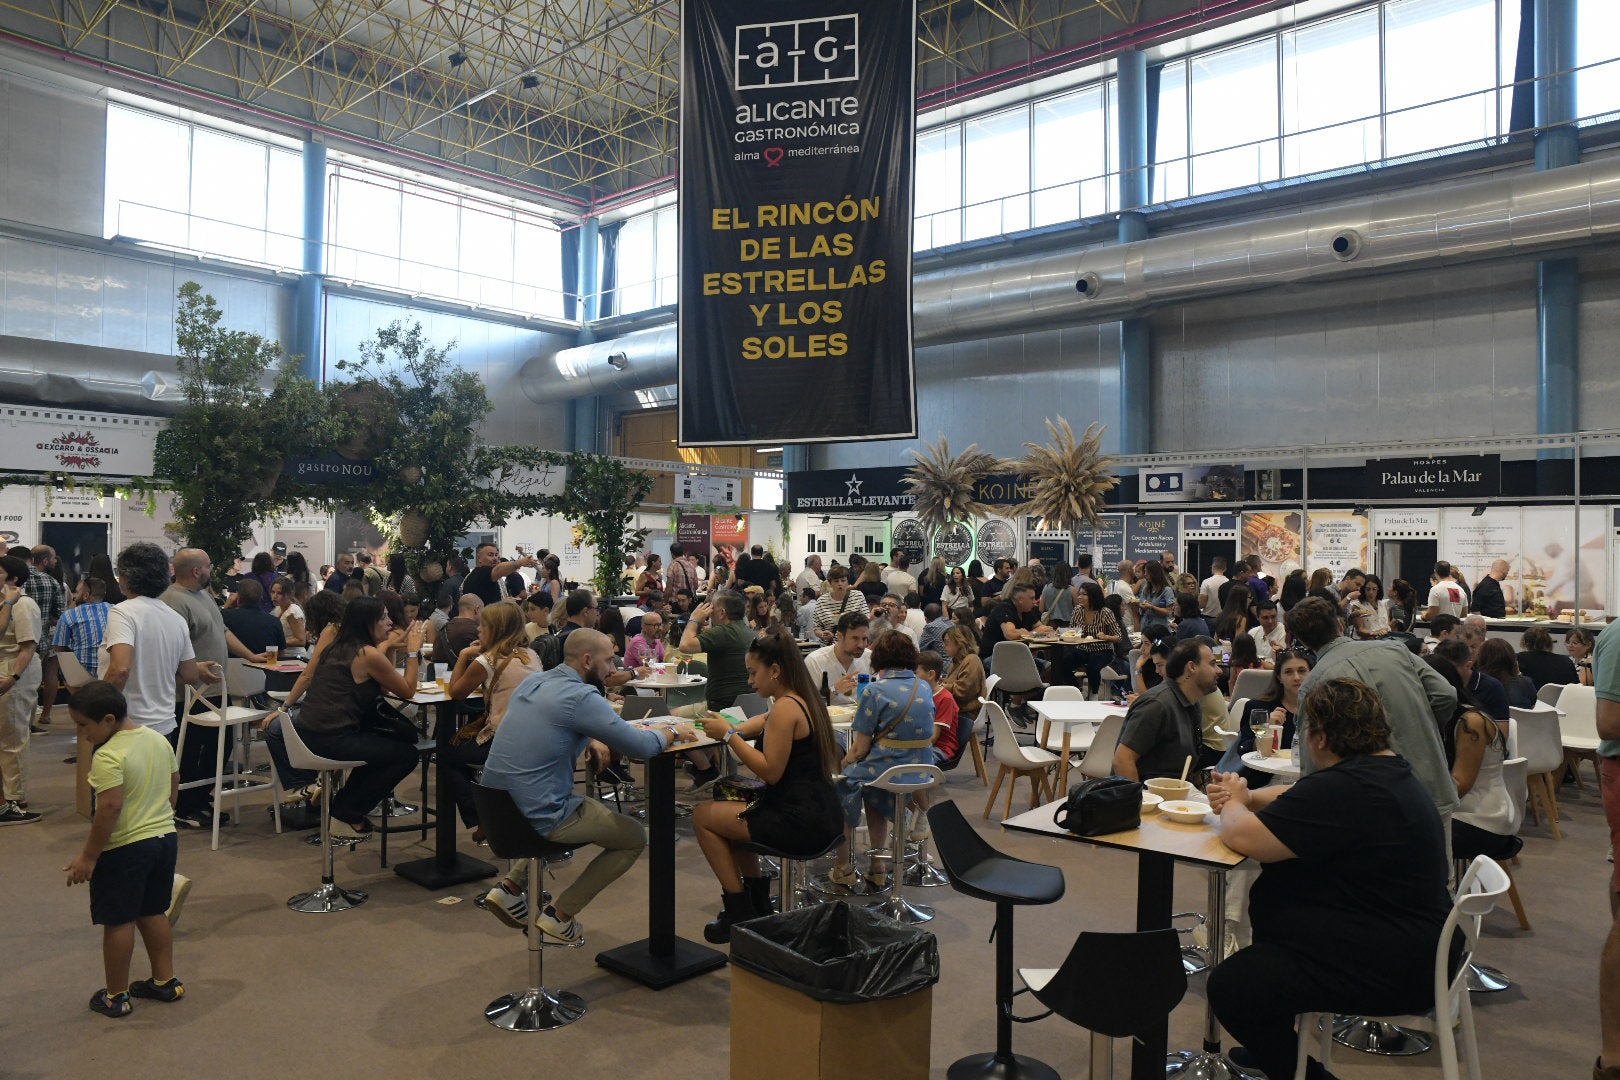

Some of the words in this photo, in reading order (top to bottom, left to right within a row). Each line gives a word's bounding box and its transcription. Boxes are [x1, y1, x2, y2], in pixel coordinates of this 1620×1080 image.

[734, 151, 760, 161] alma
[787, 143, 860, 157] mediterránea
[711, 207, 750, 230] EL
[757, 194, 881, 228] RINCÓN
[740, 238, 781, 262] DE
[789, 232, 854, 259] LAS
[702, 259, 887, 296] ESTRELLAS
[749, 303, 771, 327] Y
[778, 300, 843, 326] LOS
[741, 332, 849, 360] SOLES
[1381, 471, 1417, 485] Palau
[1418, 470, 1436, 484] de
[1438, 470, 1450, 483] la
[1452, 469, 1483, 483] Mar
[796, 496, 854, 508] ESTRELLA
[862, 494, 917, 506] LEVANTE
